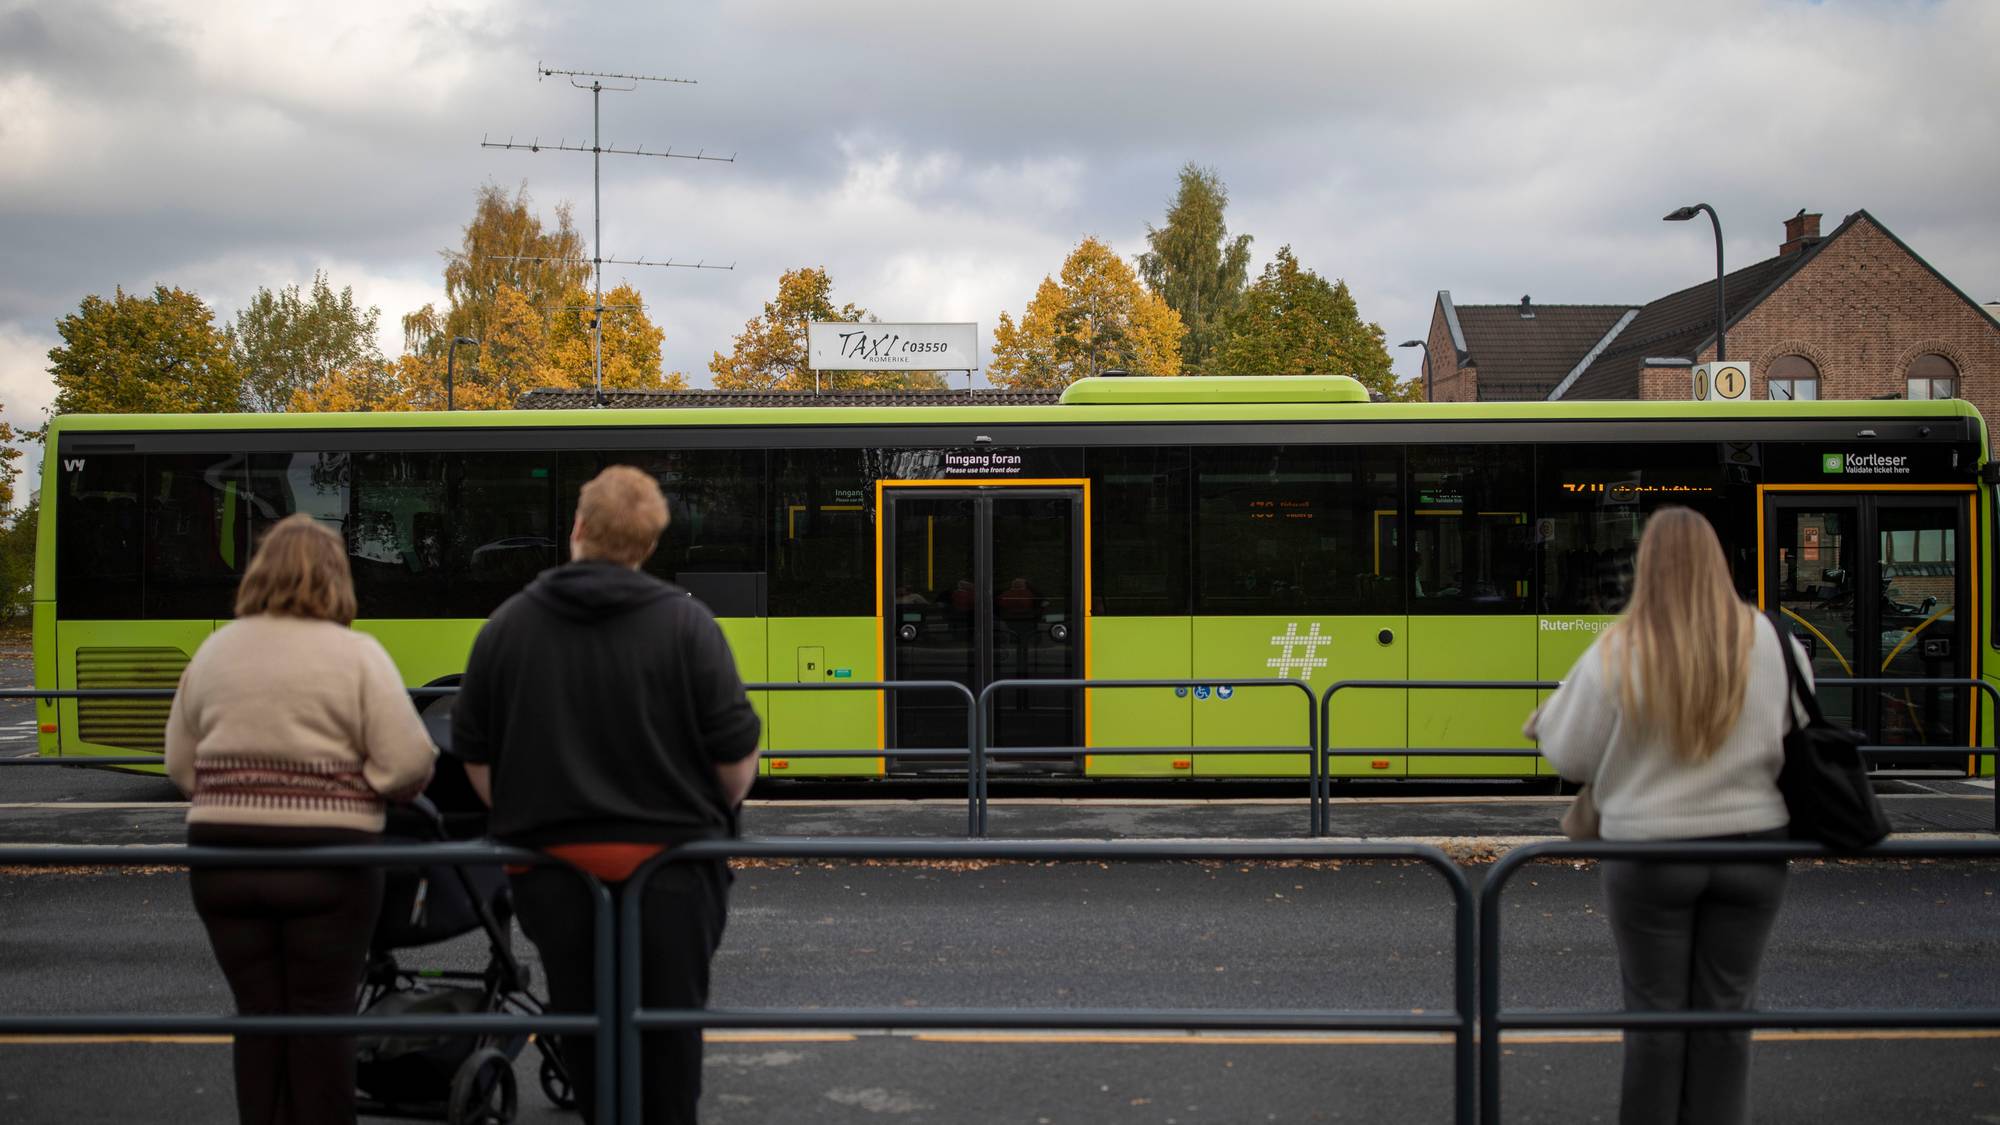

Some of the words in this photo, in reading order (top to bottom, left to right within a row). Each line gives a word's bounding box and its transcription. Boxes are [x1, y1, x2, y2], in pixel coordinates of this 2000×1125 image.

[839, 331, 899, 359] TAXI
[910, 342, 947, 353] 03550
[1699, 375, 1703, 394] 1
[1725, 373, 1733, 392] 1
[945, 454, 989, 466] Inngang
[992, 453, 1021, 464] foran
[1846, 453, 1907, 466] Kortleser
